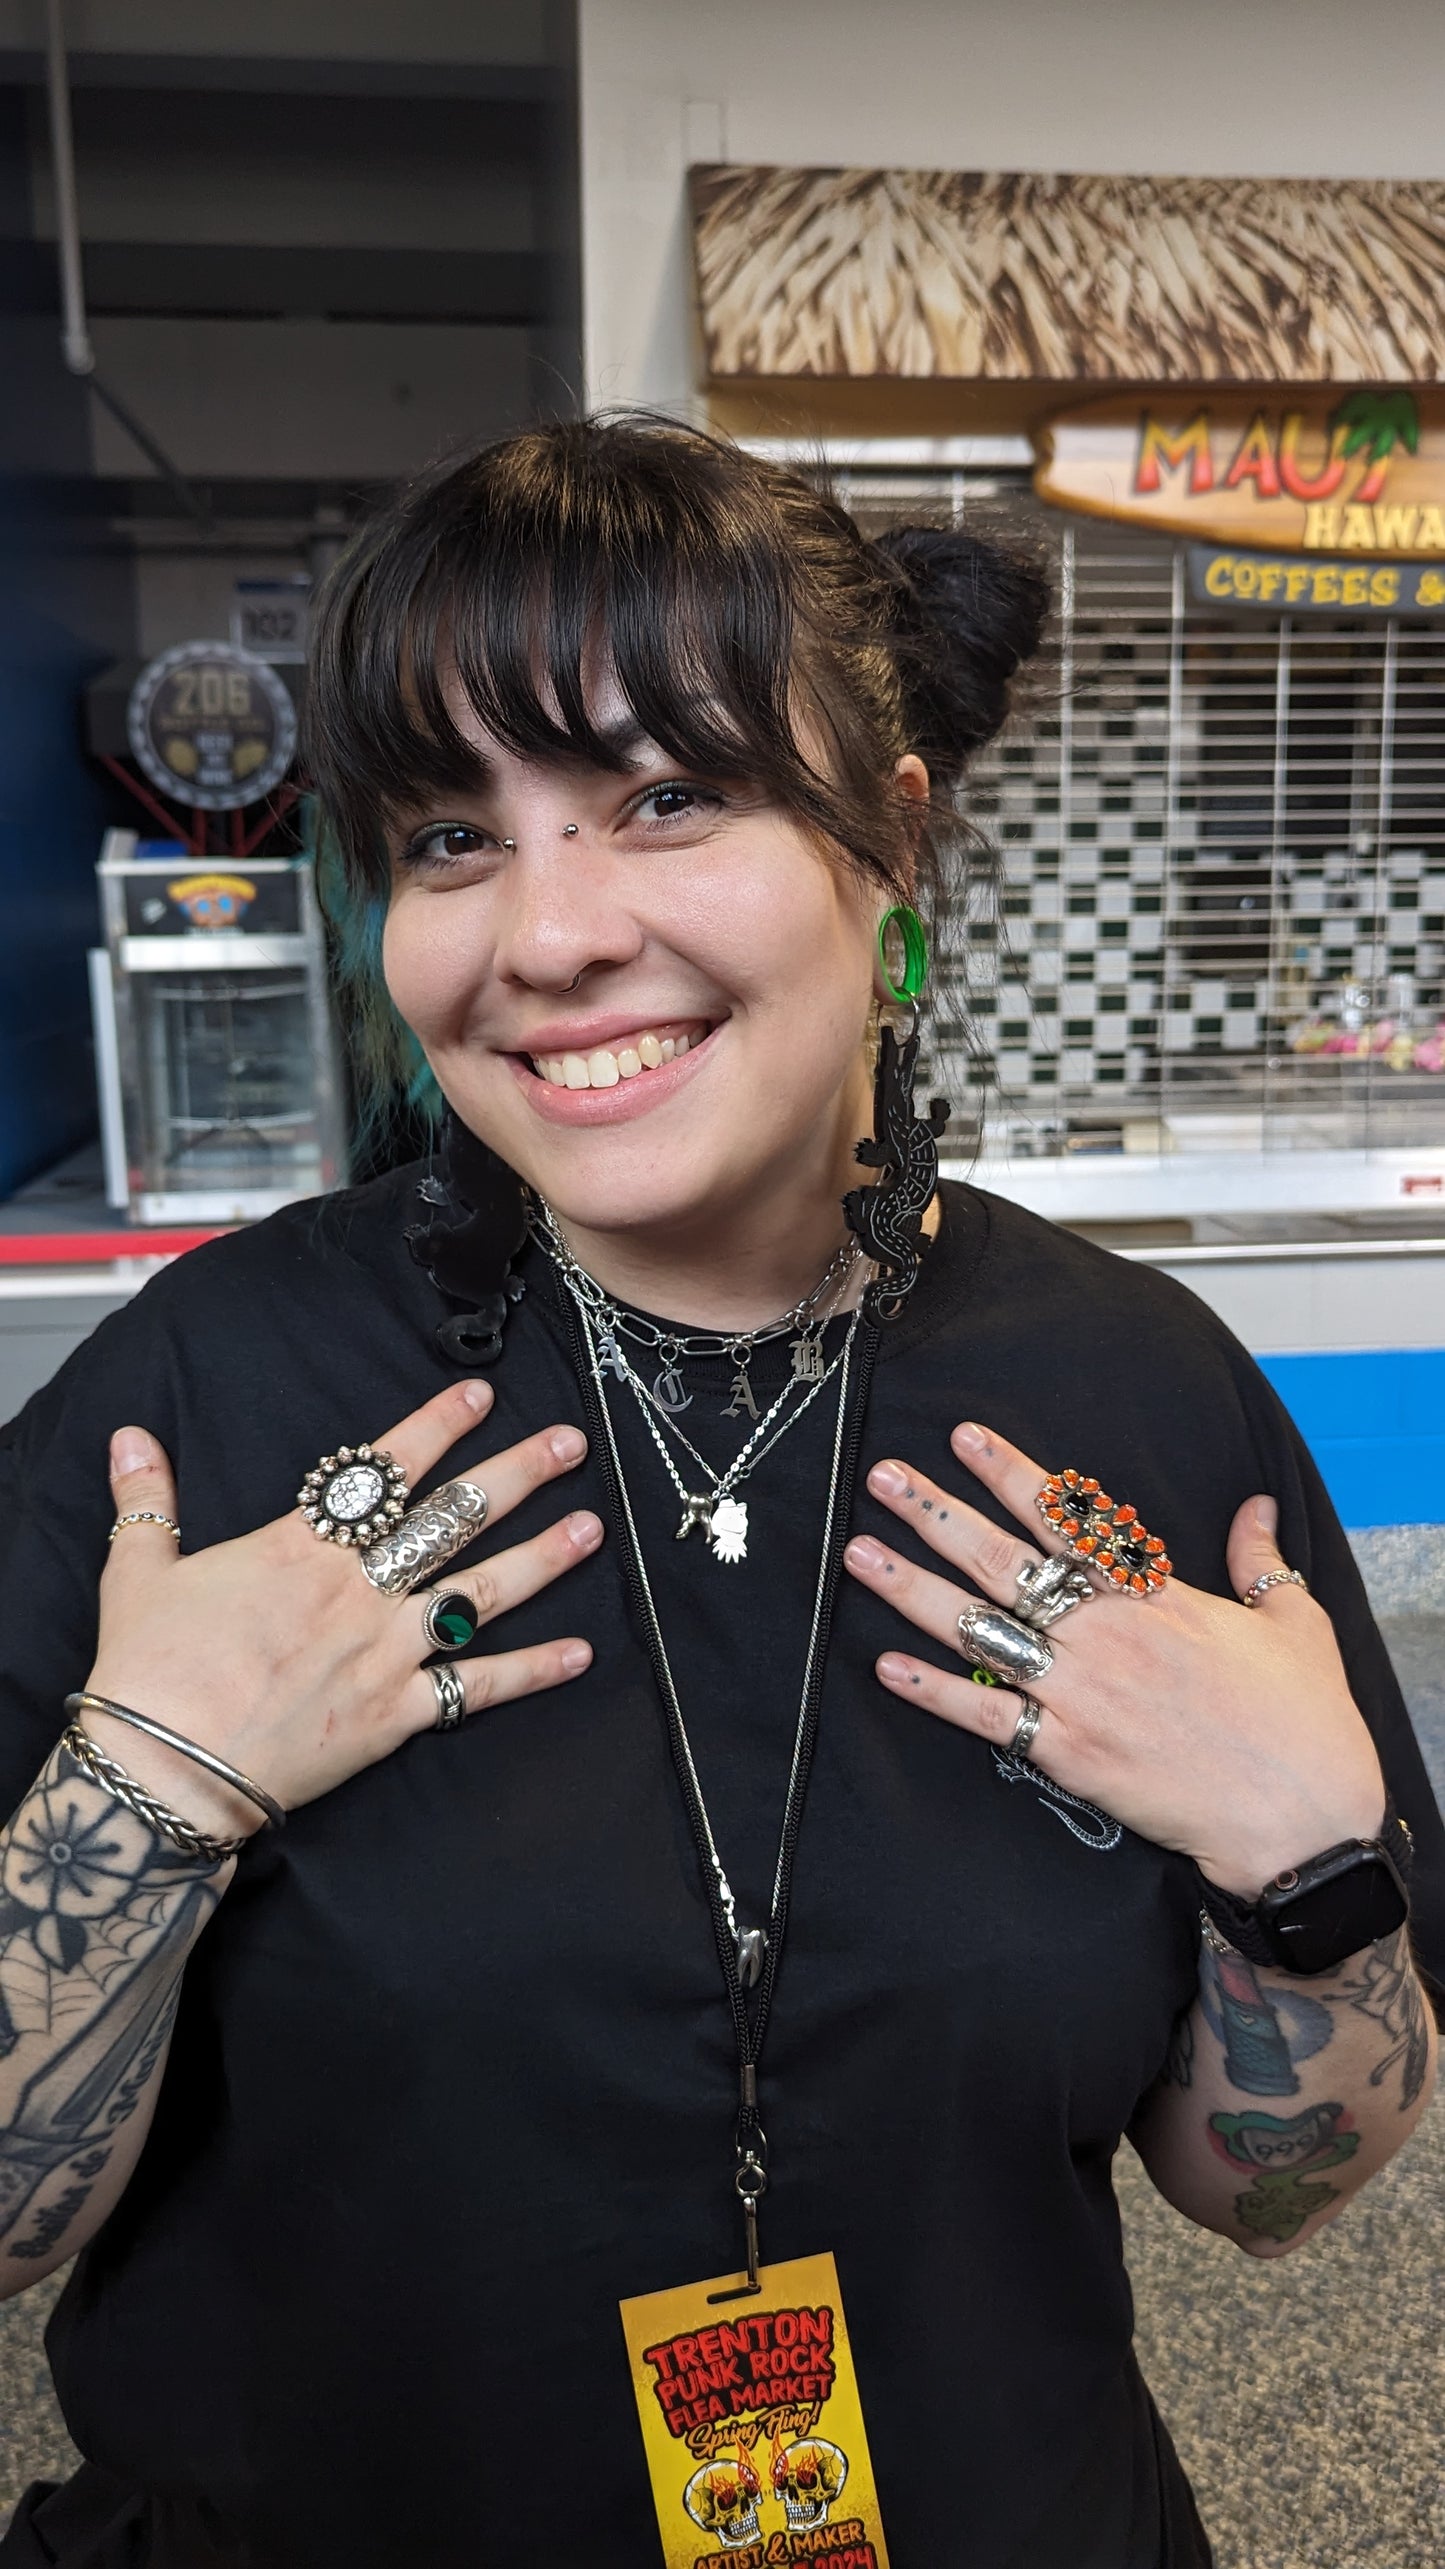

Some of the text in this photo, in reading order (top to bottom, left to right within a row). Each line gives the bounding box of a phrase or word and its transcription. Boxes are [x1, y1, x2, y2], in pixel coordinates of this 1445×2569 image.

[1205, 554, 1398, 607] COFFEES
[647, 2309, 832, 2379] TRENTON
[657, 2343, 832, 2410] PUNK ROCK
[668, 2373, 832, 2434] FLEA MARKET
[688, 2400, 822, 2457] Spring Fling!
[697, 2522, 864, 2569] ARTIST & MAKER
